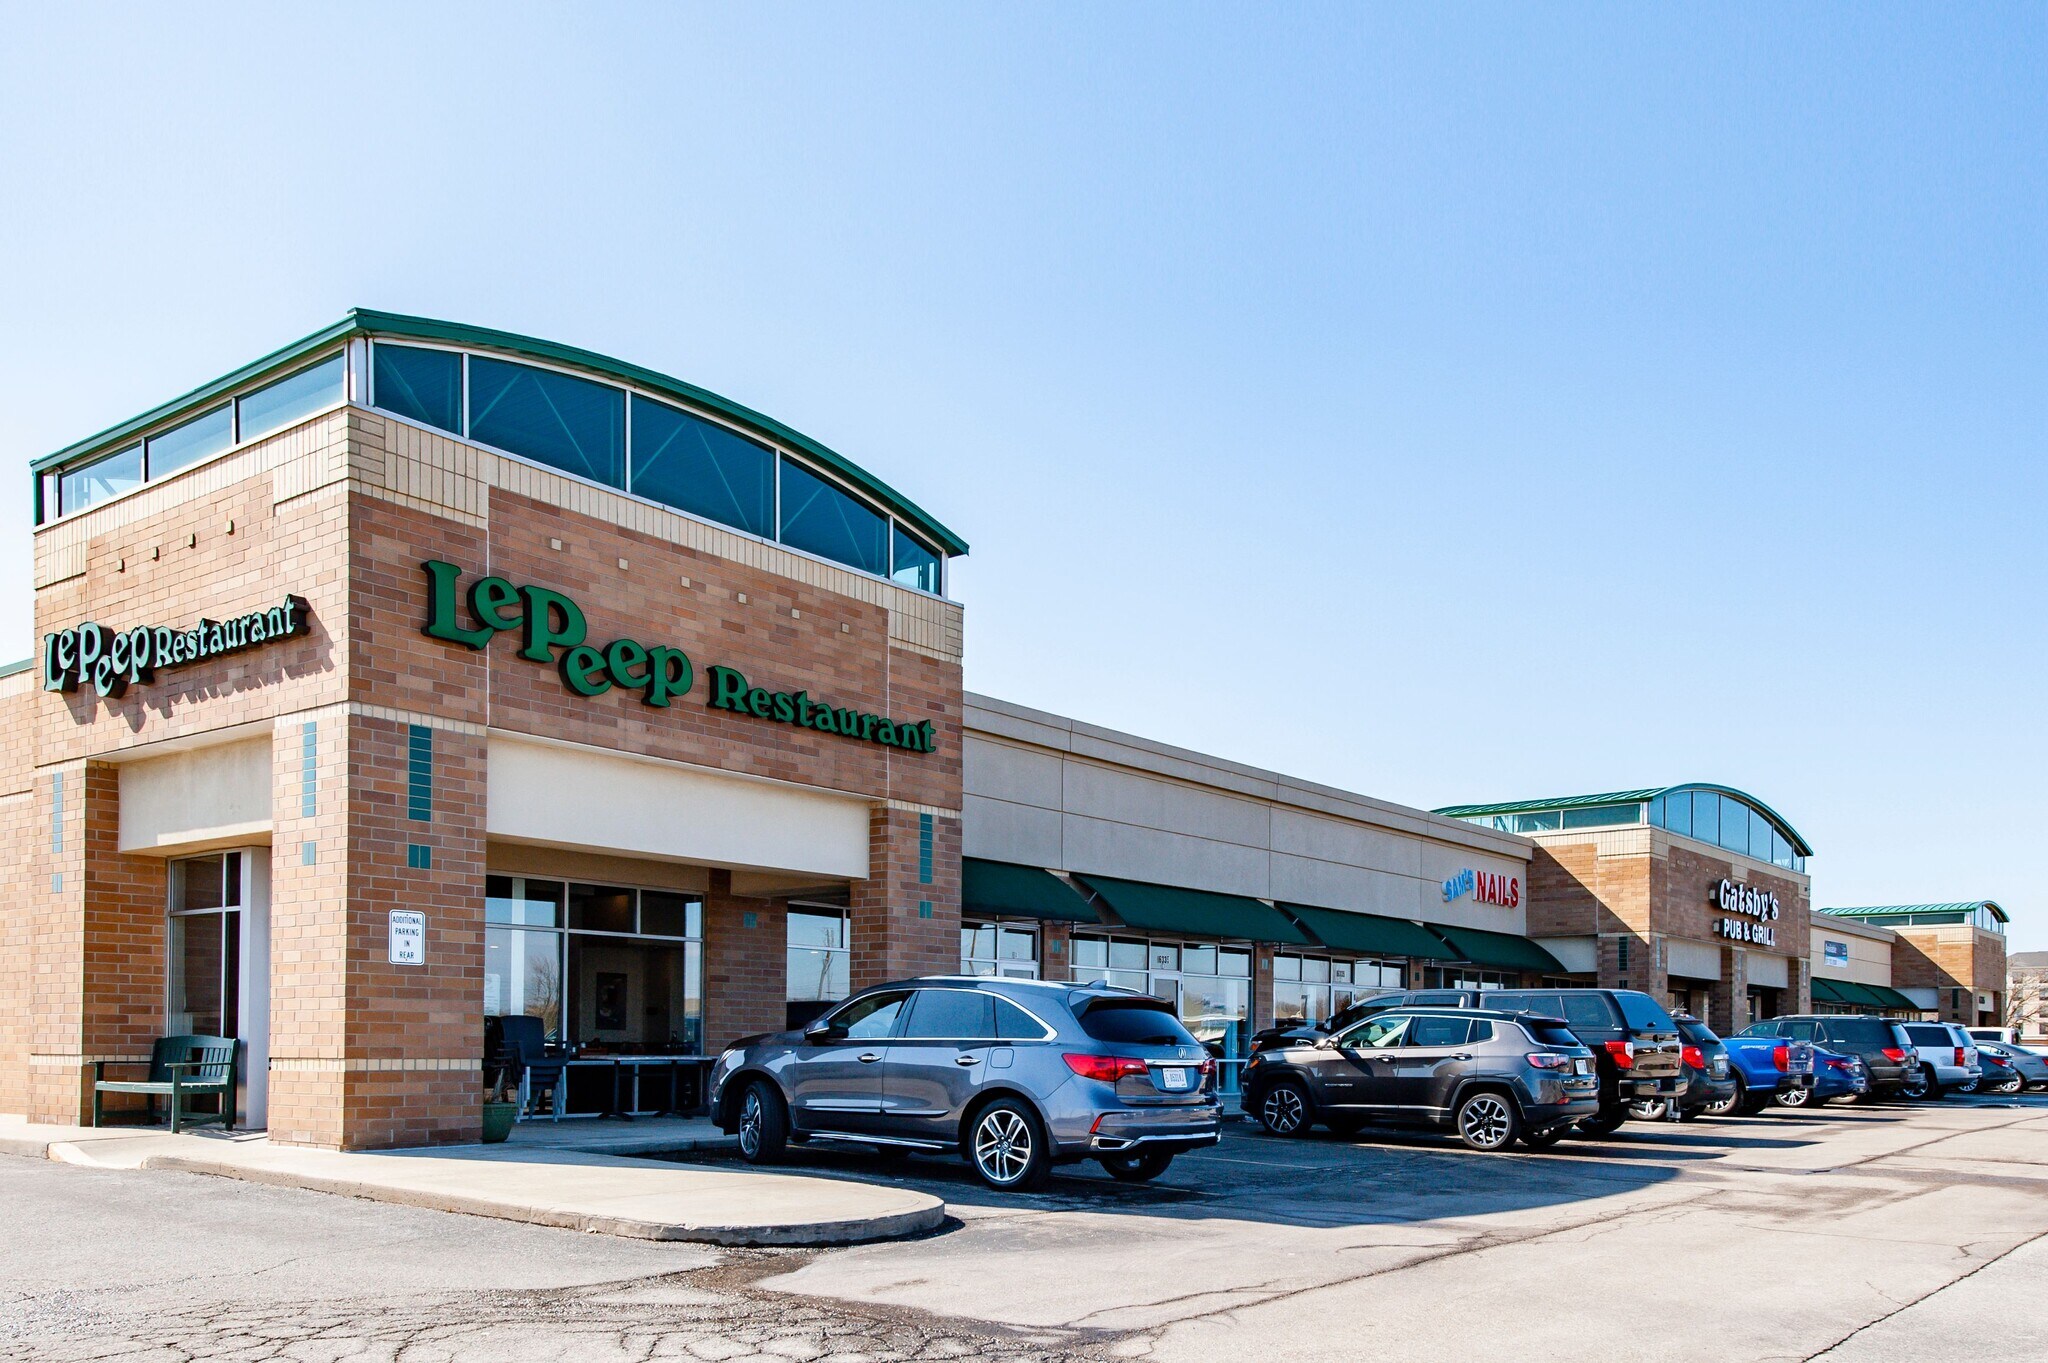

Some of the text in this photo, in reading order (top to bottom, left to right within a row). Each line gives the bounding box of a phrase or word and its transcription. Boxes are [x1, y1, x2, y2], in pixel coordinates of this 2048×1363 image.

[154, 594, 300, 668] Restaurant
[707, 665, 937, 754] Restaurant
[1476, 870, 1519, 908] NAILS
[1719, 878, 1779, 922] Gatsby's
[393, 916, 421, 925] ADDITIONAL
[395, 928, 419, 937] PARKING
[1723, 918, 1776, 946] PUB & GRILL
[400, 951, 414, 959] REAR
